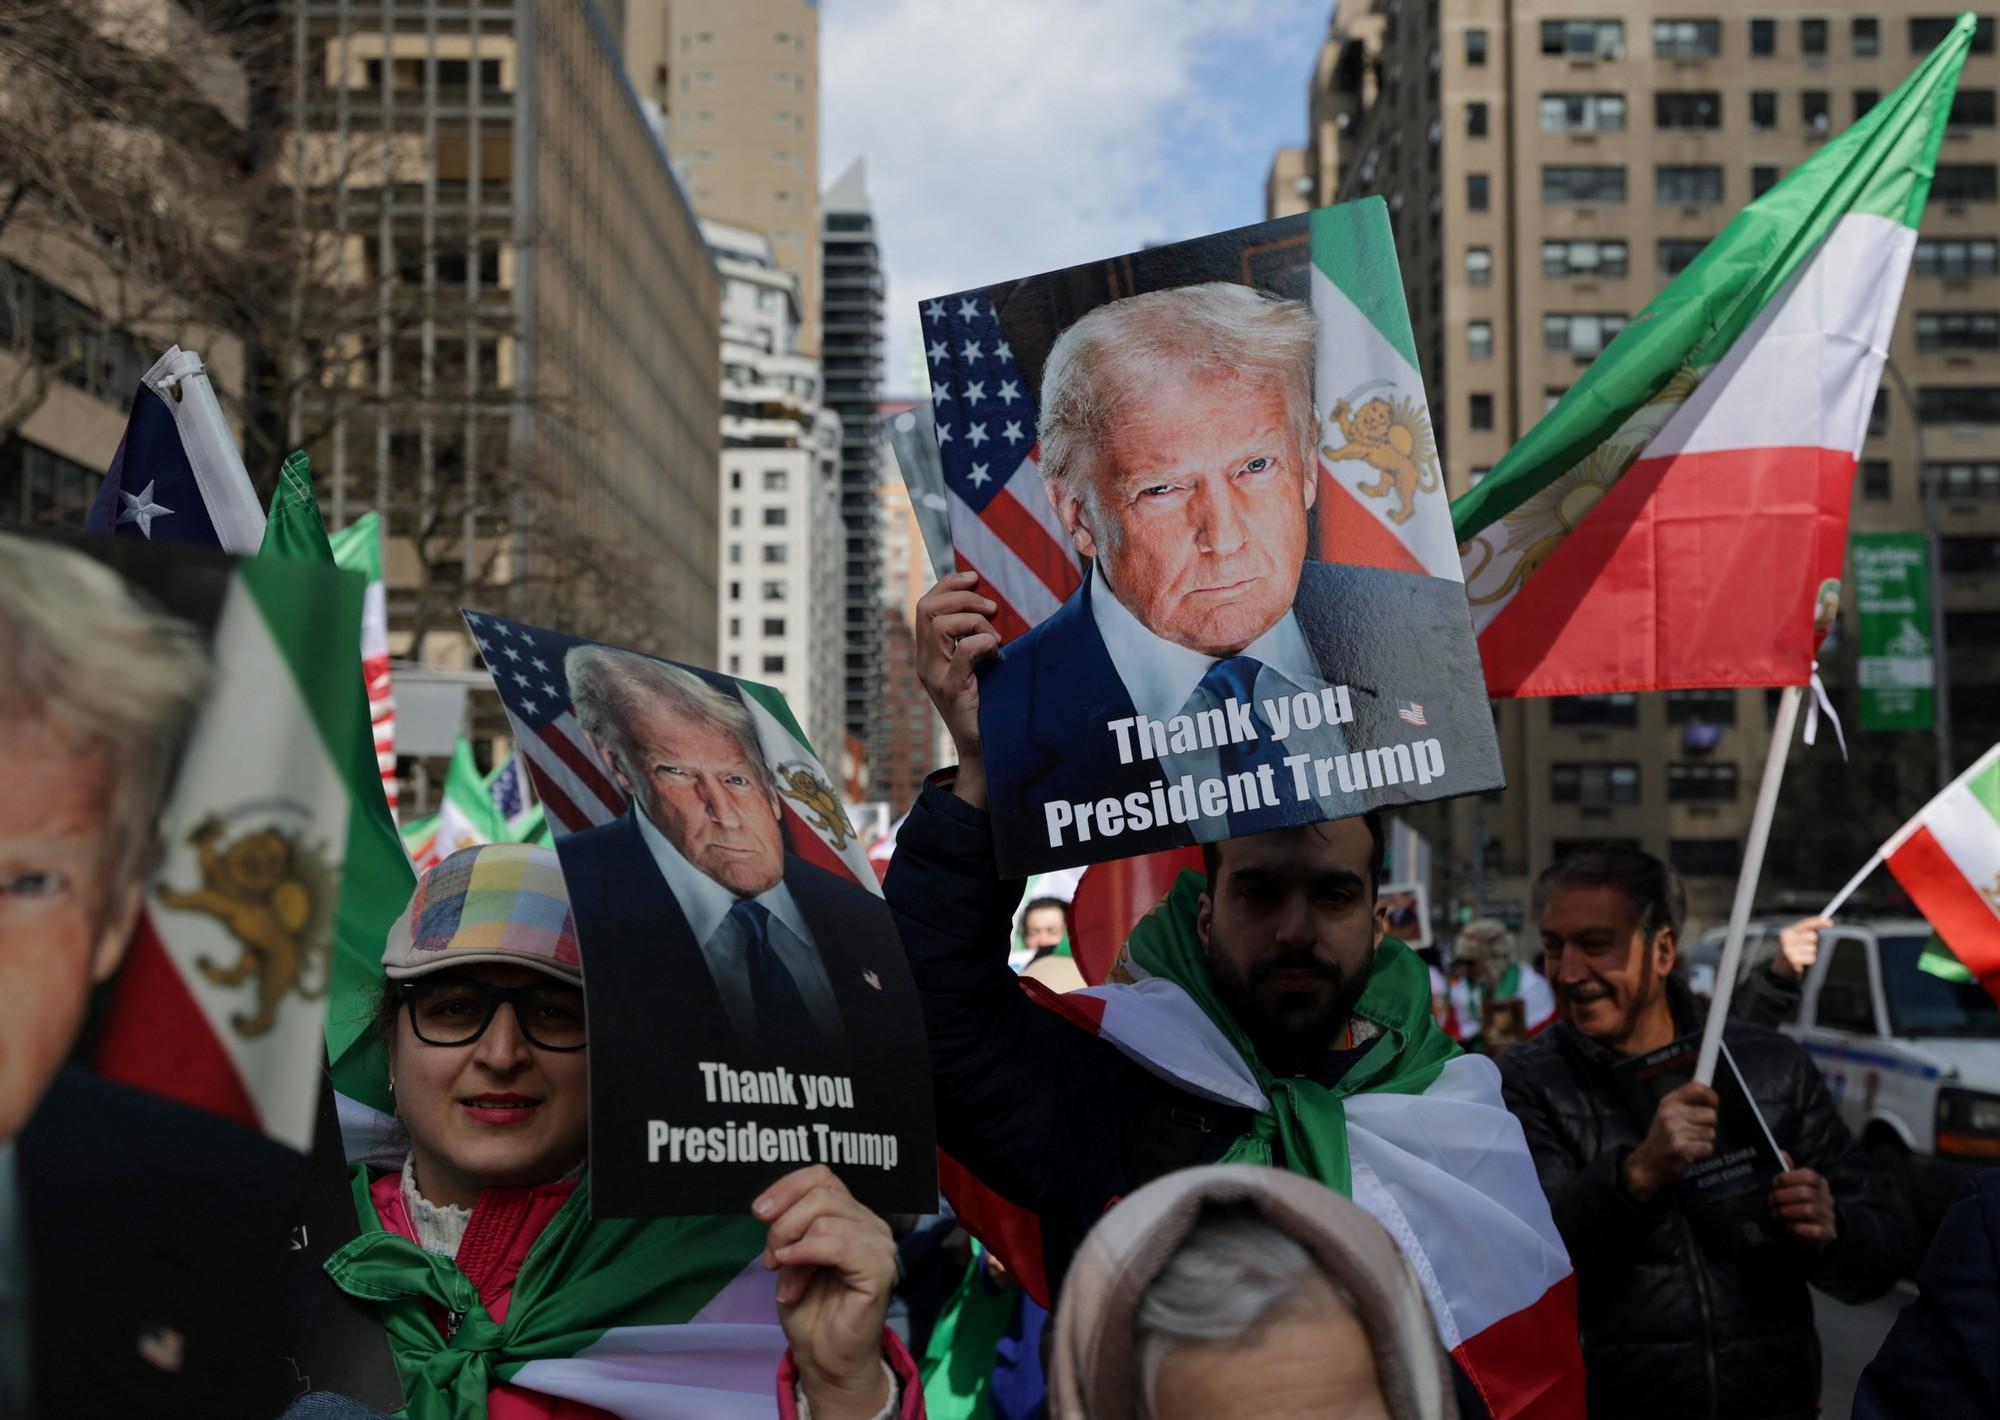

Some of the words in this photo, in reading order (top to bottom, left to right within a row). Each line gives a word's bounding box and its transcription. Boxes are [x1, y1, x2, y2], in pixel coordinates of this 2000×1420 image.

[1107, 697, 1259, 765] Thank
[1263, 684, 1355, 740] you
[1043, 763, 1281, 849] President
[1283, 736, 1446, 802] Trump
[698, 1061, 799, 1106] Thank
[799, 1074, 855, 1111] you
[647, 1119, 812, 1164] President
[812, 1123, 899, 1171] Trump
